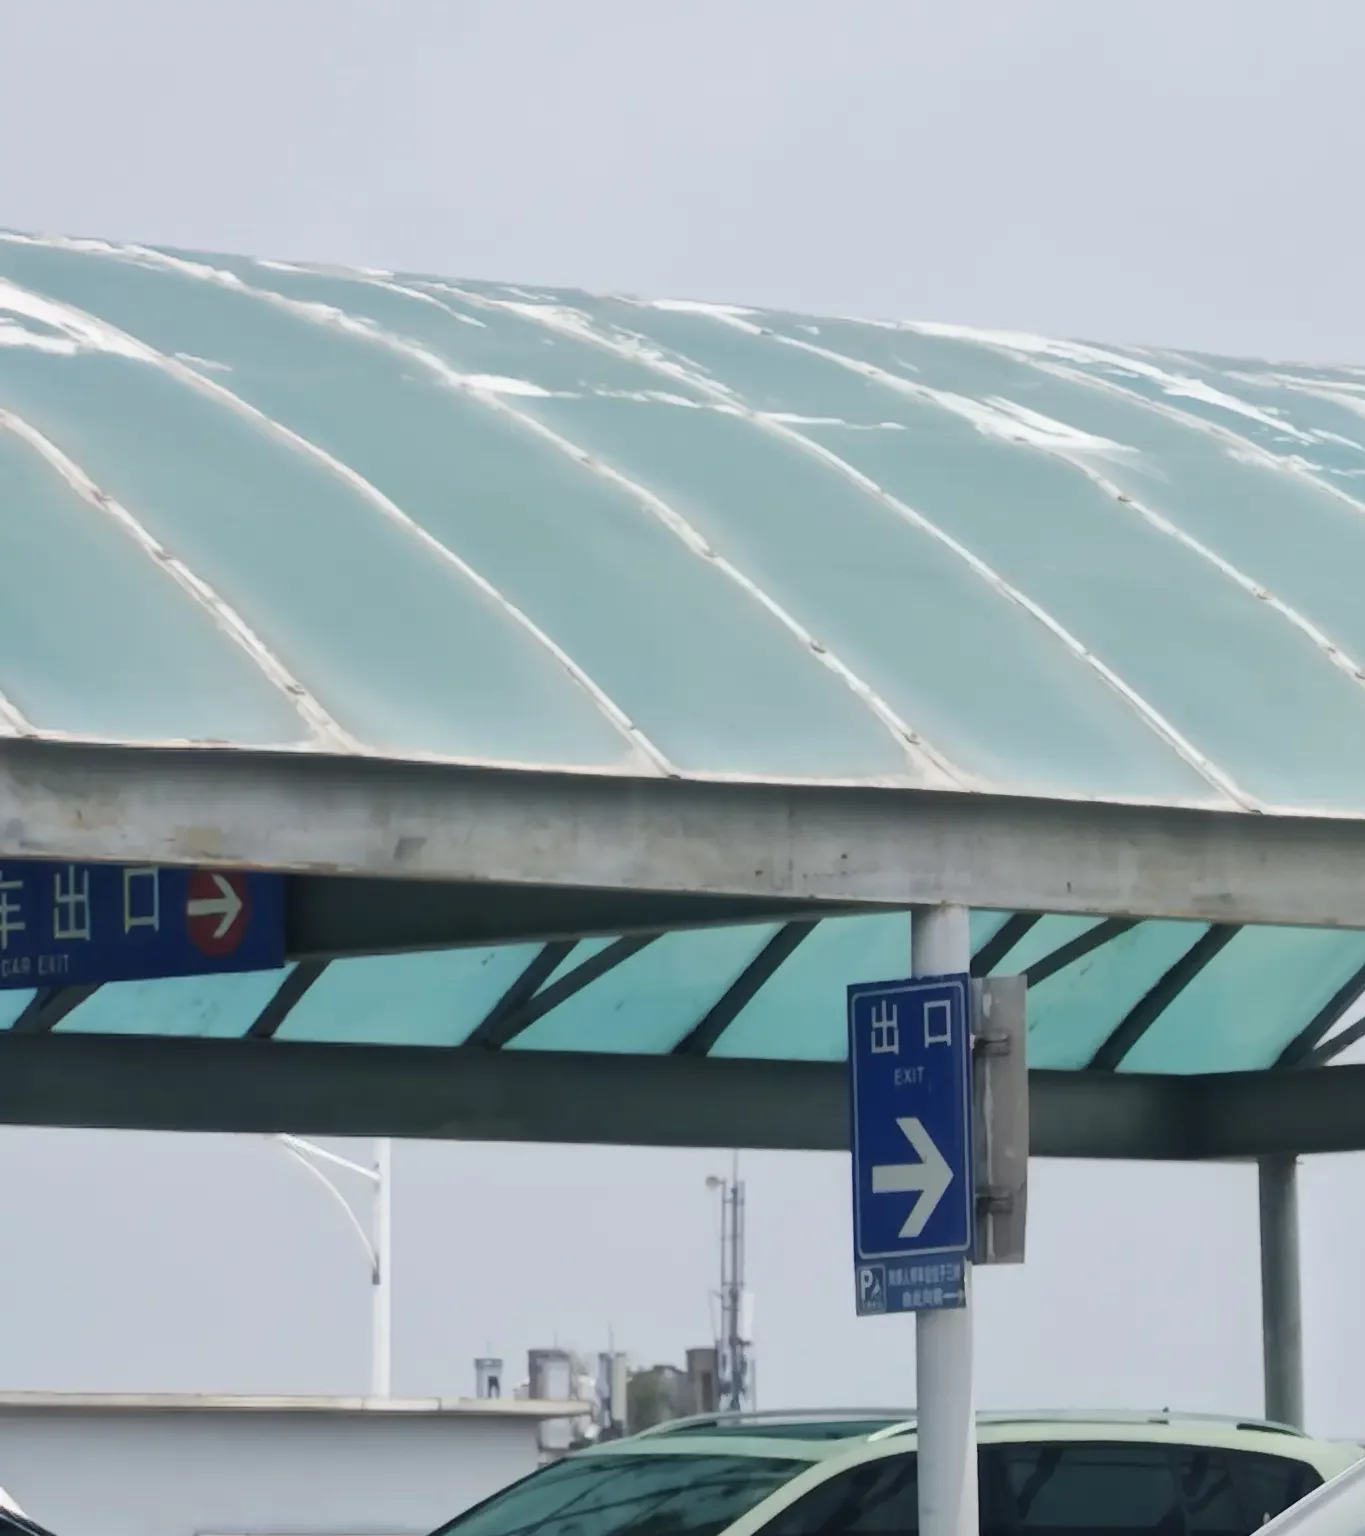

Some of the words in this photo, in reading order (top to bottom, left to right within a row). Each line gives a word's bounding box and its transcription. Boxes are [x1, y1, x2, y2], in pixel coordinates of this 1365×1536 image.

[38, 954, 70, 976] EXIT
[871, 999, 952, 1055] 出口
[894, 1066, 925, 1086] EXIT
